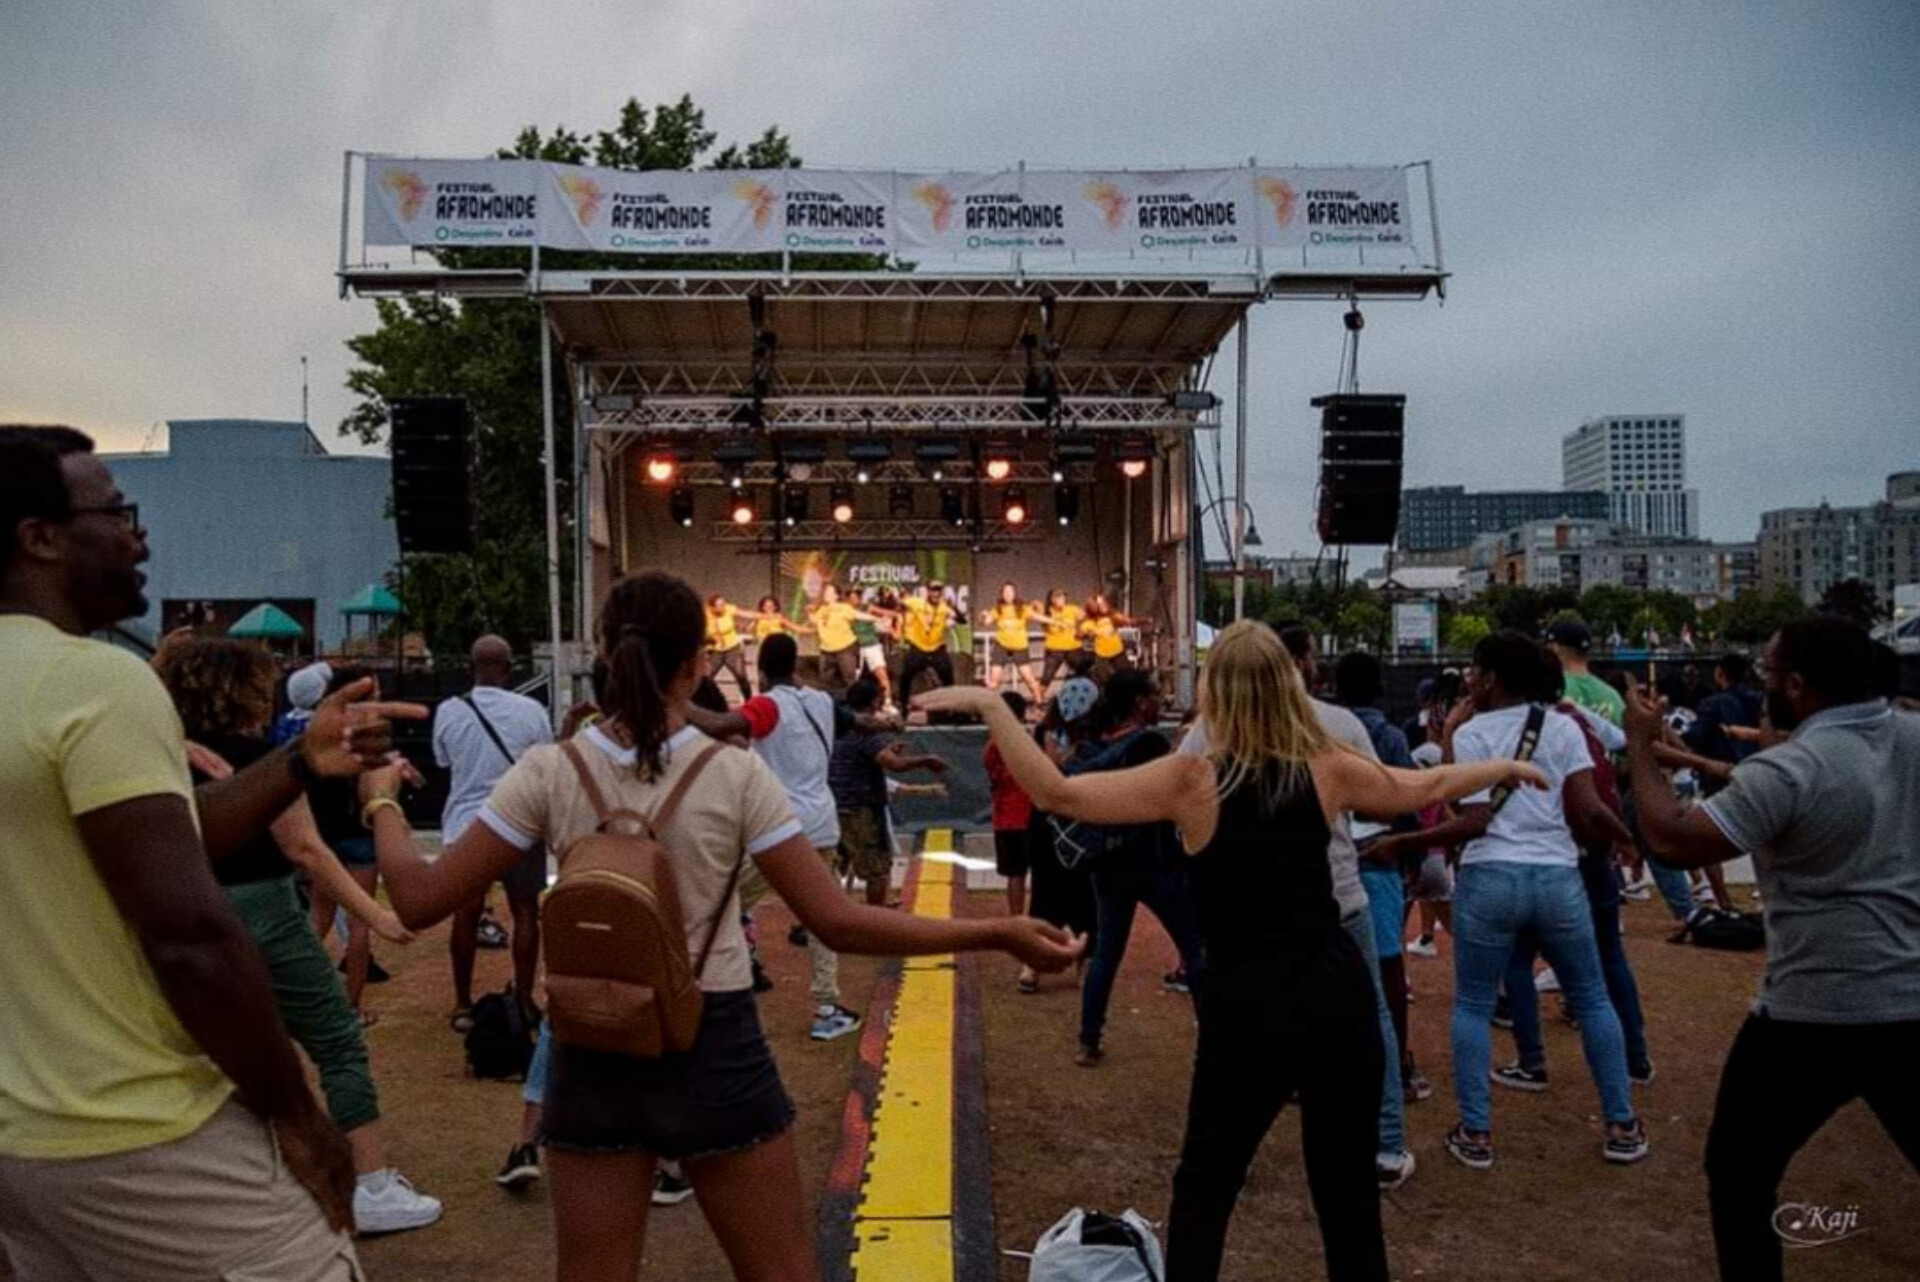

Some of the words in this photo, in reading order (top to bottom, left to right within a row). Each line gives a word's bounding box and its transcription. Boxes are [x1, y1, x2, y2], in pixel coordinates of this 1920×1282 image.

[437, 183, 494, 193] FESTIVAL
[786, 192, 843, 202] FESTIVAL
[1306, 190, 1359, 200] FESTIVAL
[436, 195, 536, 219] AFROMONDE
[613, 193, 669, 204] FESTIVAL
[965, 194, 1022, 204] FESTIVAL
[1138, 194, 1193, 204] FESTIVAL
[611, 205, 711, 229] AFROMONDE
[786, 204, 885, 228] AFROMONDE
[966, 205, 1063, 229] AFROMONDE
[1138, 202, 1236, 228] AFROMONDE
[1307, 202, 1400, 224] AFROMONDE
[849, 564, 920, 582] FESTIVAL
